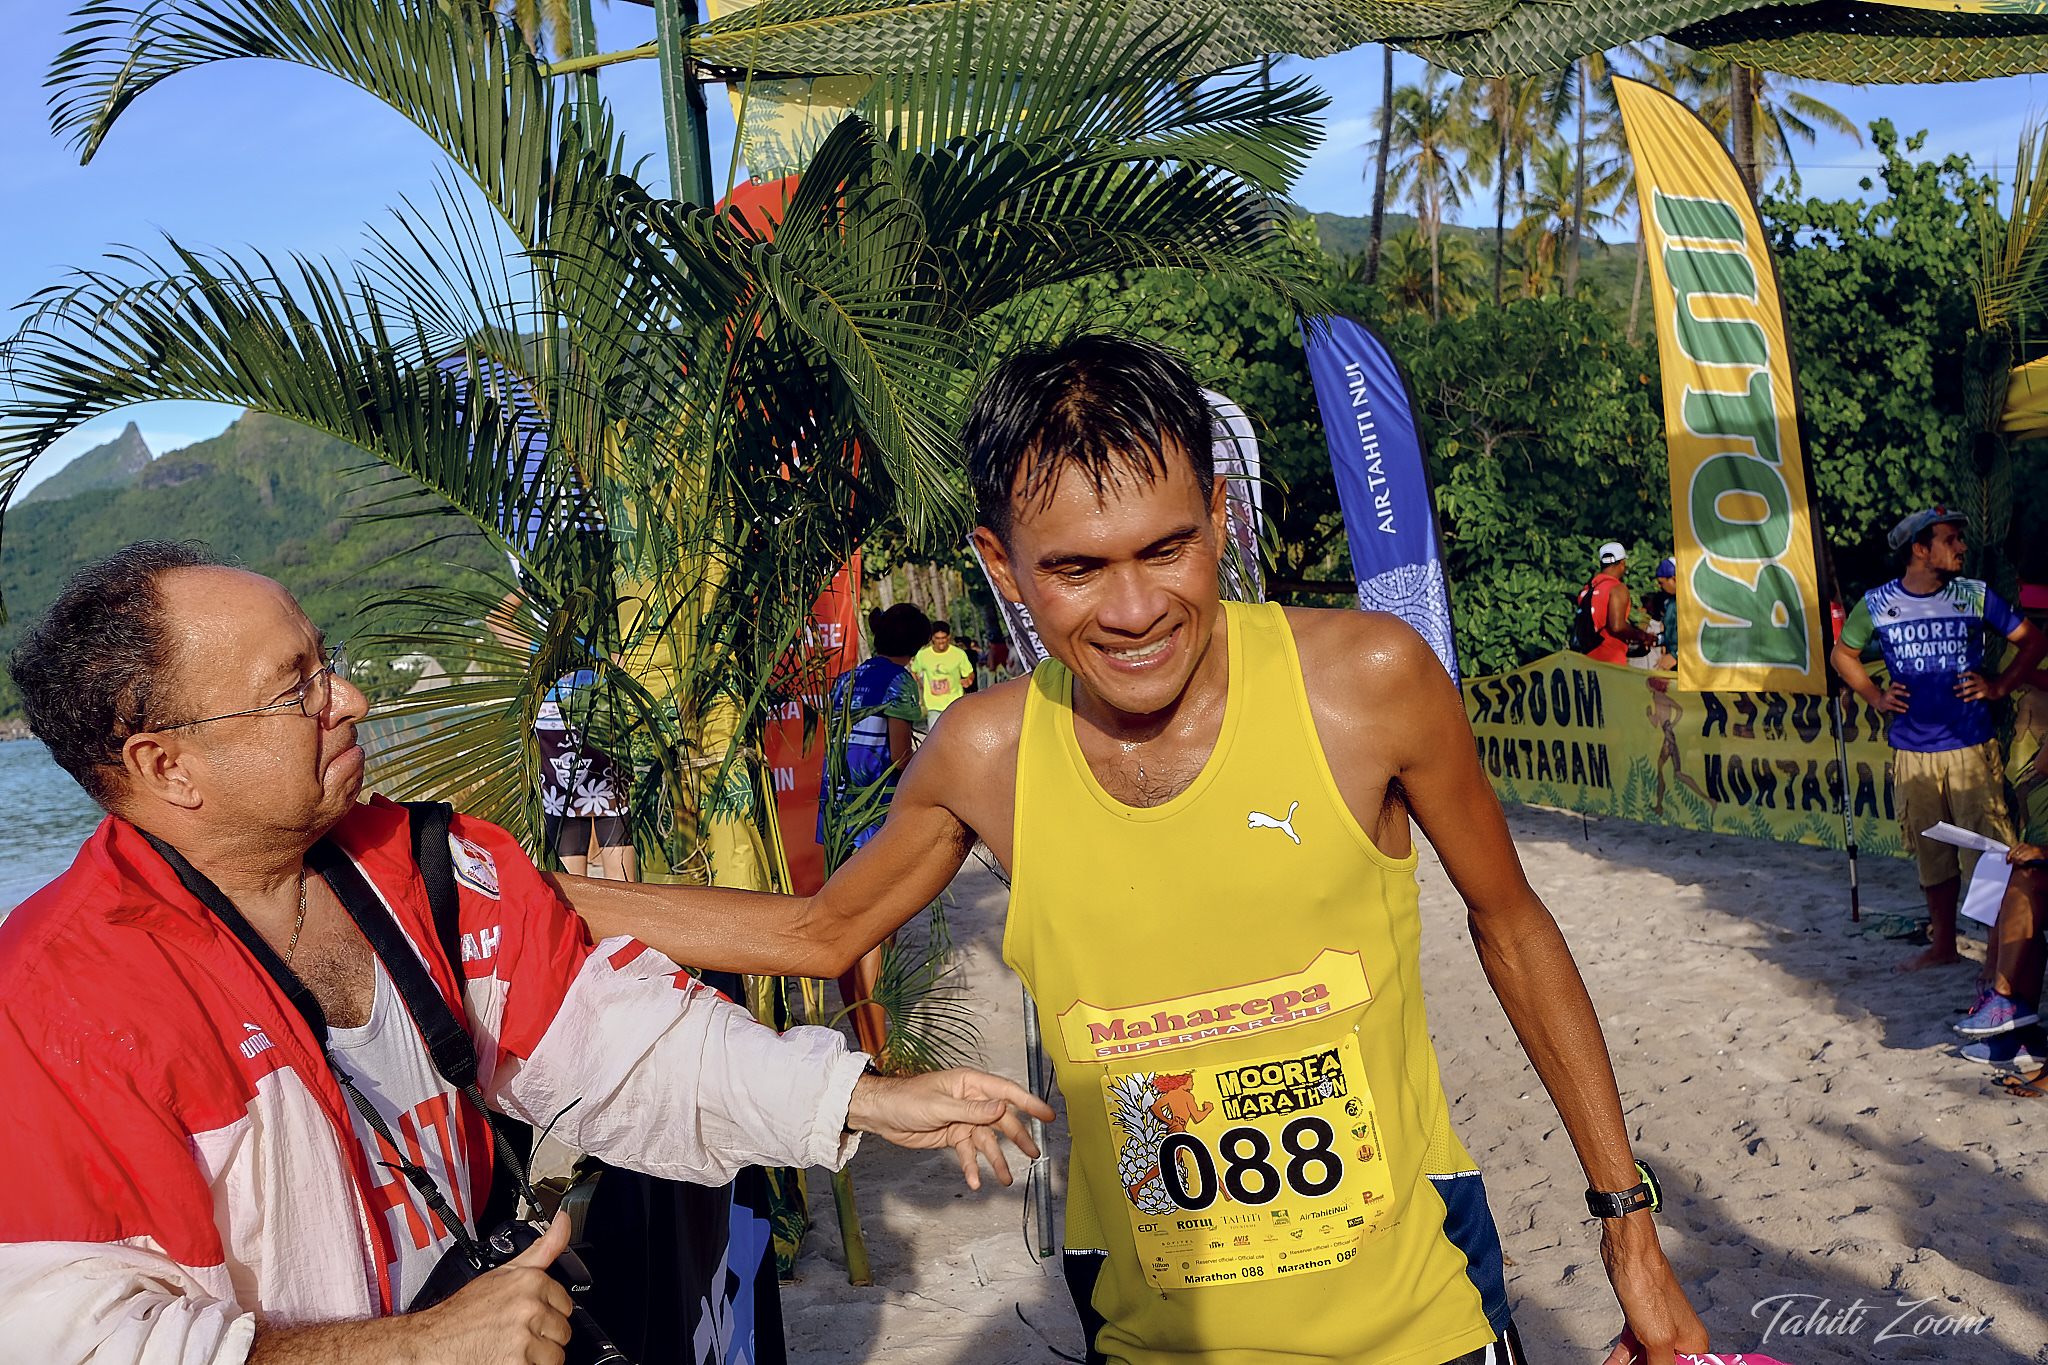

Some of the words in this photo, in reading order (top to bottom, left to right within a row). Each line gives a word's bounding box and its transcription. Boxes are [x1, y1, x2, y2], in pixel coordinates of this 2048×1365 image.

[1345, 362, 1369, 407] NUI
[1356, 411, 1387, 493] TAHITI
[1374, 487, 1397, 534] AIR
[1888, 621, 1969, 643] MOOREA
[1893, 640, 1968, 659] MARATHON
[461, 925, 502, 962] AH
[1087, 983, 1331, 1045] Maharepa
[1098, 1004, 1330, 1056] SUPERMARCHE
[1217, 1051, 1341, 1098] MOOREA
[1223, 1075, 1347, 1120] MARATHON
[1158, 1115, 1345, 1211] 088
[1138, 1223, 1158, 1233] EDT
[1176, 1218, 1213, 1229] ROTUI
[1220, 1213, 1261, 1225] TAHITI
[1233, 1235, 1249, 1243] AVIS
[1184, 1271, 1237, 1284] Marathon
[1241, 1266, 1264, 1278] 088
[1277, 1259, 1332, 1274] Marathon
[1336, 1247, 1357, 1263] 088
